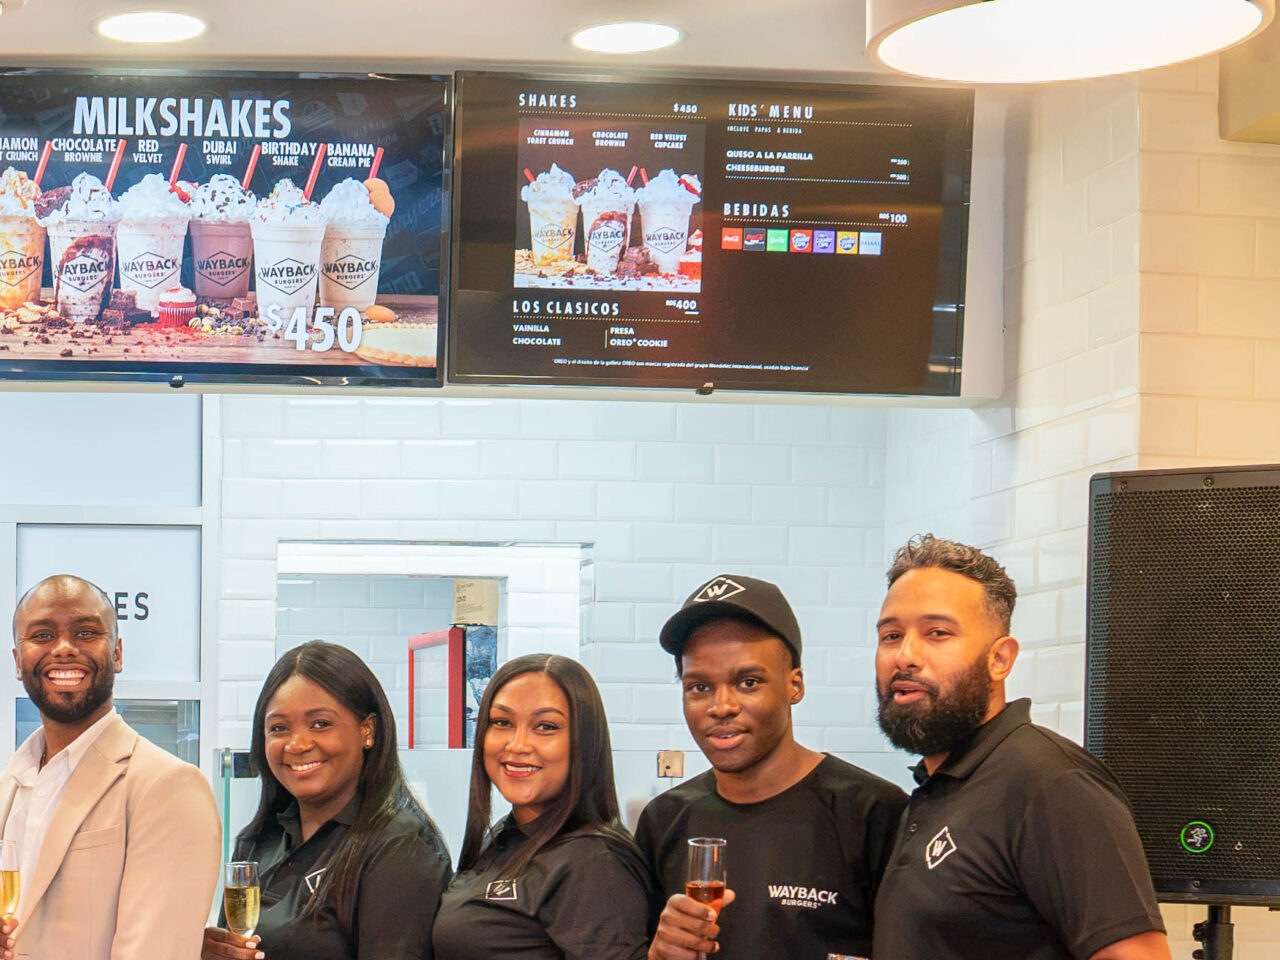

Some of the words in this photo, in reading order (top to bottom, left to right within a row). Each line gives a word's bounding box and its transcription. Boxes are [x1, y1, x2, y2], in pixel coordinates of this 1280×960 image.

[519, 93, 577, 108] SHAKES
[673, 103, 698, 114] $450
[769, 105, 814, 119] MENU
[73, 96, 292, 139] MILKSHAKES
[533, 129, 570, 137] CINNAMON
[592, 131, 628, 139] CHOCOLATE
[51, 138, 117, 152] CHOCOLATE
[138, 139, 159, 153] RED
[527, 137, 547, 145] TOAST
[654, 141, 684, 149] CUPCAKE
[203, 141, 237, 155] DUBAI
[261, 142, 318, 156] BIRTHDAY
[327, 143, 375, 157] BANANA
[6, 152, 38, 162] CRUNCH
[64, 152, 103, 163] BROWNIE
[132, 153, 163, 163] VELVET
[206, 156, 232, 165] SWIRL
[272, 156, 299, 166] SHAKE
[726, 150, 754, 159] QUESO
[756, 151, 763, 159] A
[765, 151, 775, 159] LA
[776, 152, 814, 161] PARRILLA
[328, 157, 356, 167] CREAM
[358, 158, 371, 167] PIE
[726, 164, 786, 173] CHEESEBURGER
[723, 203, 790, 218] BEBIDAS
[645, 232, 685, 242] WAYBACK
[123, 258, 178, 272] WAYBACK
[197, 257, 248, 270] WAYBACK
[324, 260, 376, 274] WAYBACK
[261, 264, 315, 278] WAYBACK
[513, 300, 540, 313] LOS
[546, 301, 619, 316] CLASICOS
[267, 303, 363, 353] $450
[513, 324, 550, 333] VAINILLA
[610, 327, 635, 335] FRESA
[513, 337, 562, 346] CHOCOLATE
[637, 339, 669, 348] COOKIE
[707, 584, 728, 598] W
[931, 840, 947, 857] W
[768, 885, 838, 905] WAYBACK
